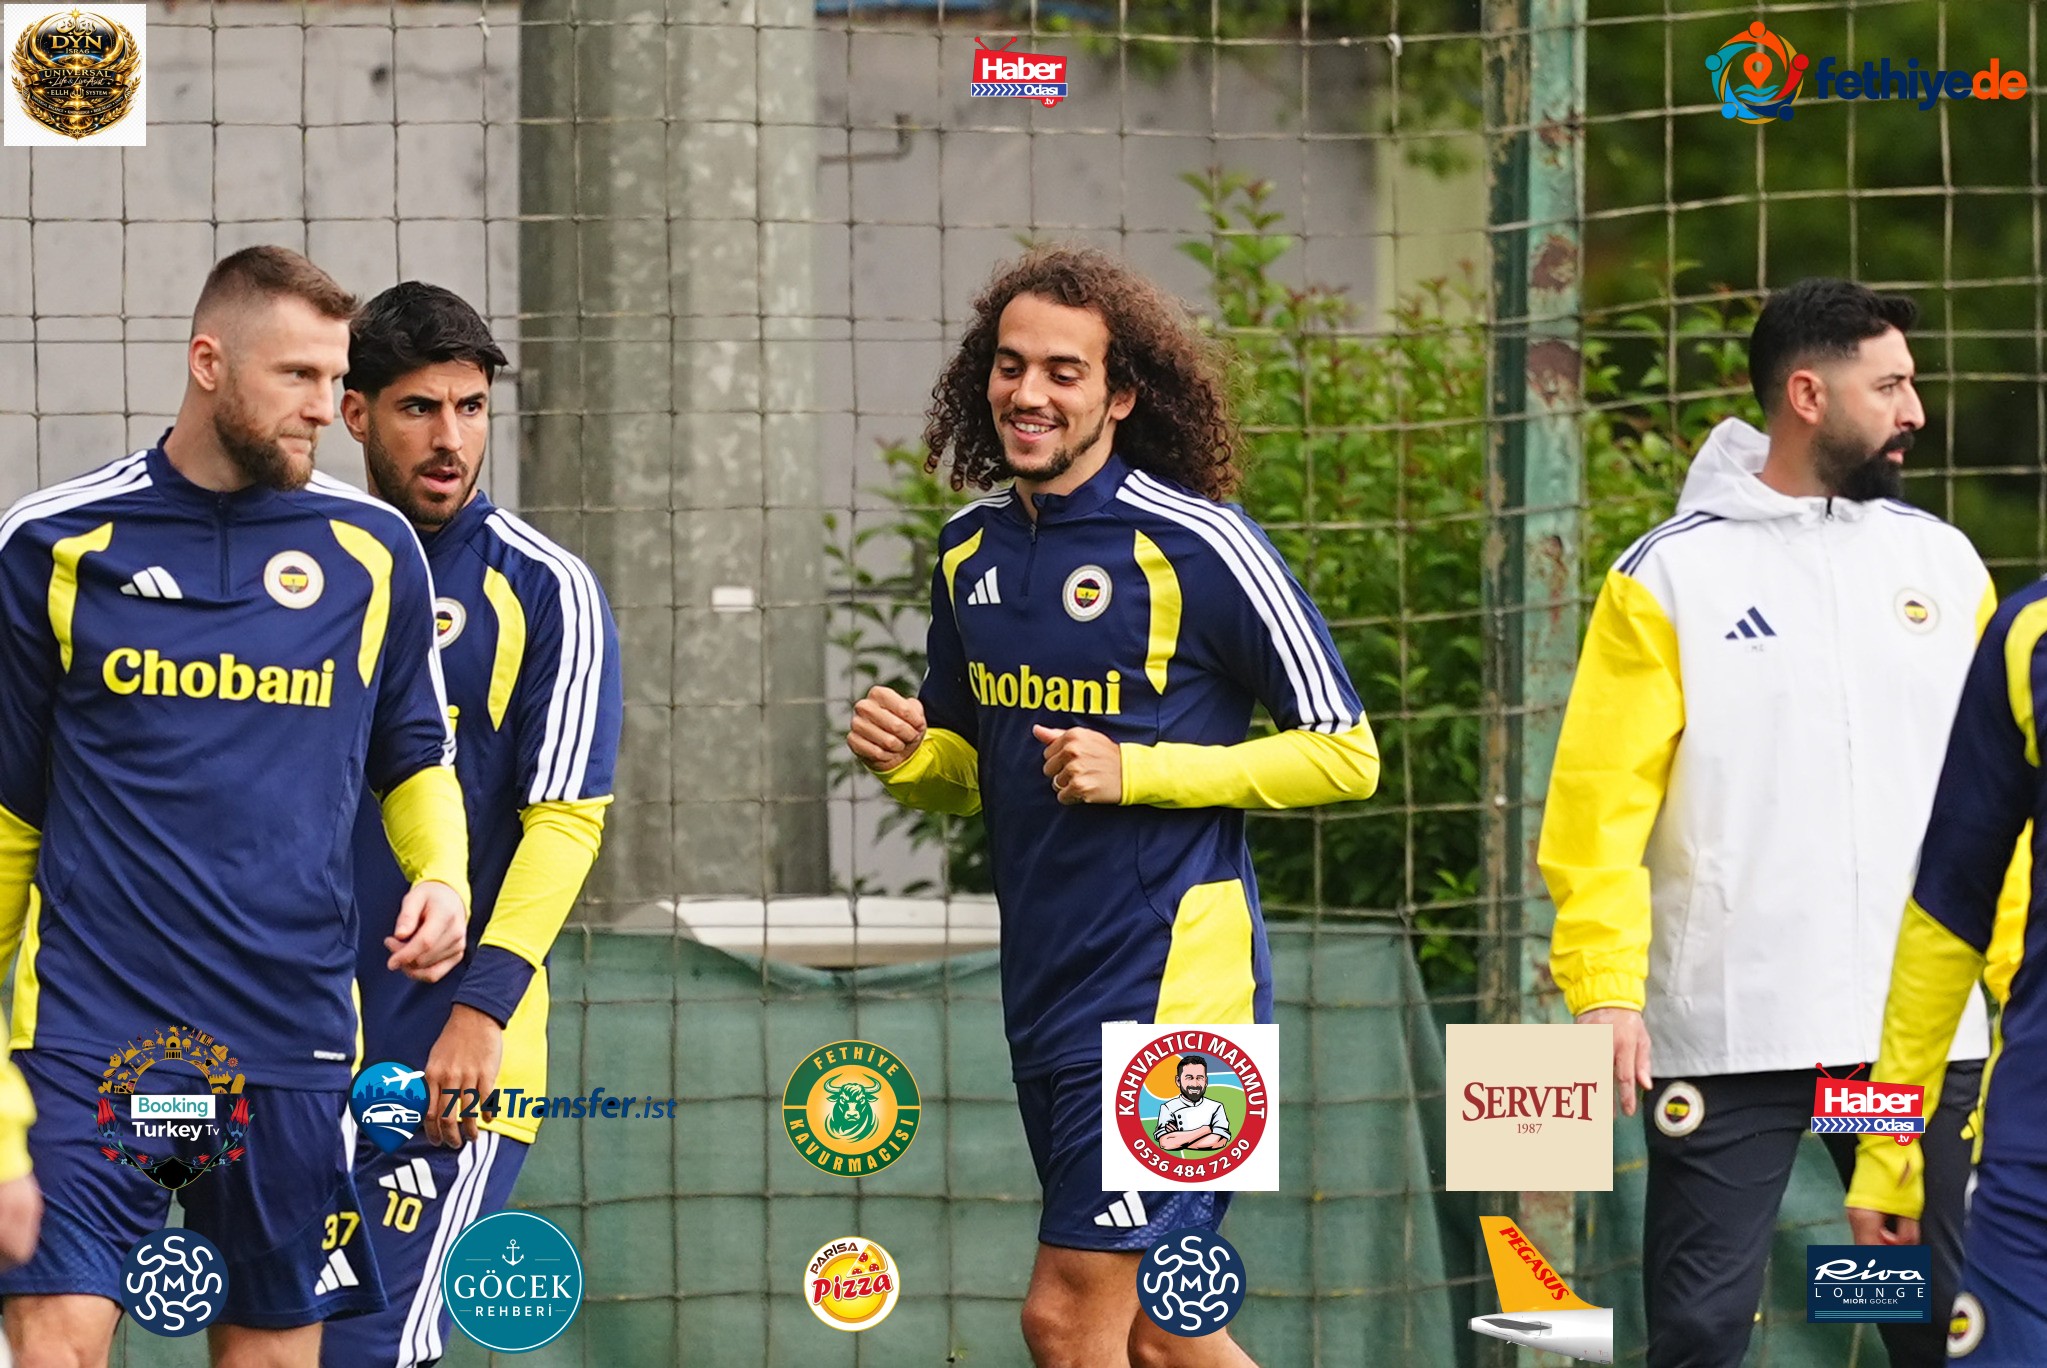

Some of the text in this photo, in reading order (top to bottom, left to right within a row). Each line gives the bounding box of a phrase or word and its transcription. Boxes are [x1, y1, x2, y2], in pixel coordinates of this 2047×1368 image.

[102, 647, 335, 708] Chobani
[968, 661, 1122, 715] Chobani
[321, 1211, 361, 1250] 37
[382, 1190, 423, 1233] 10
